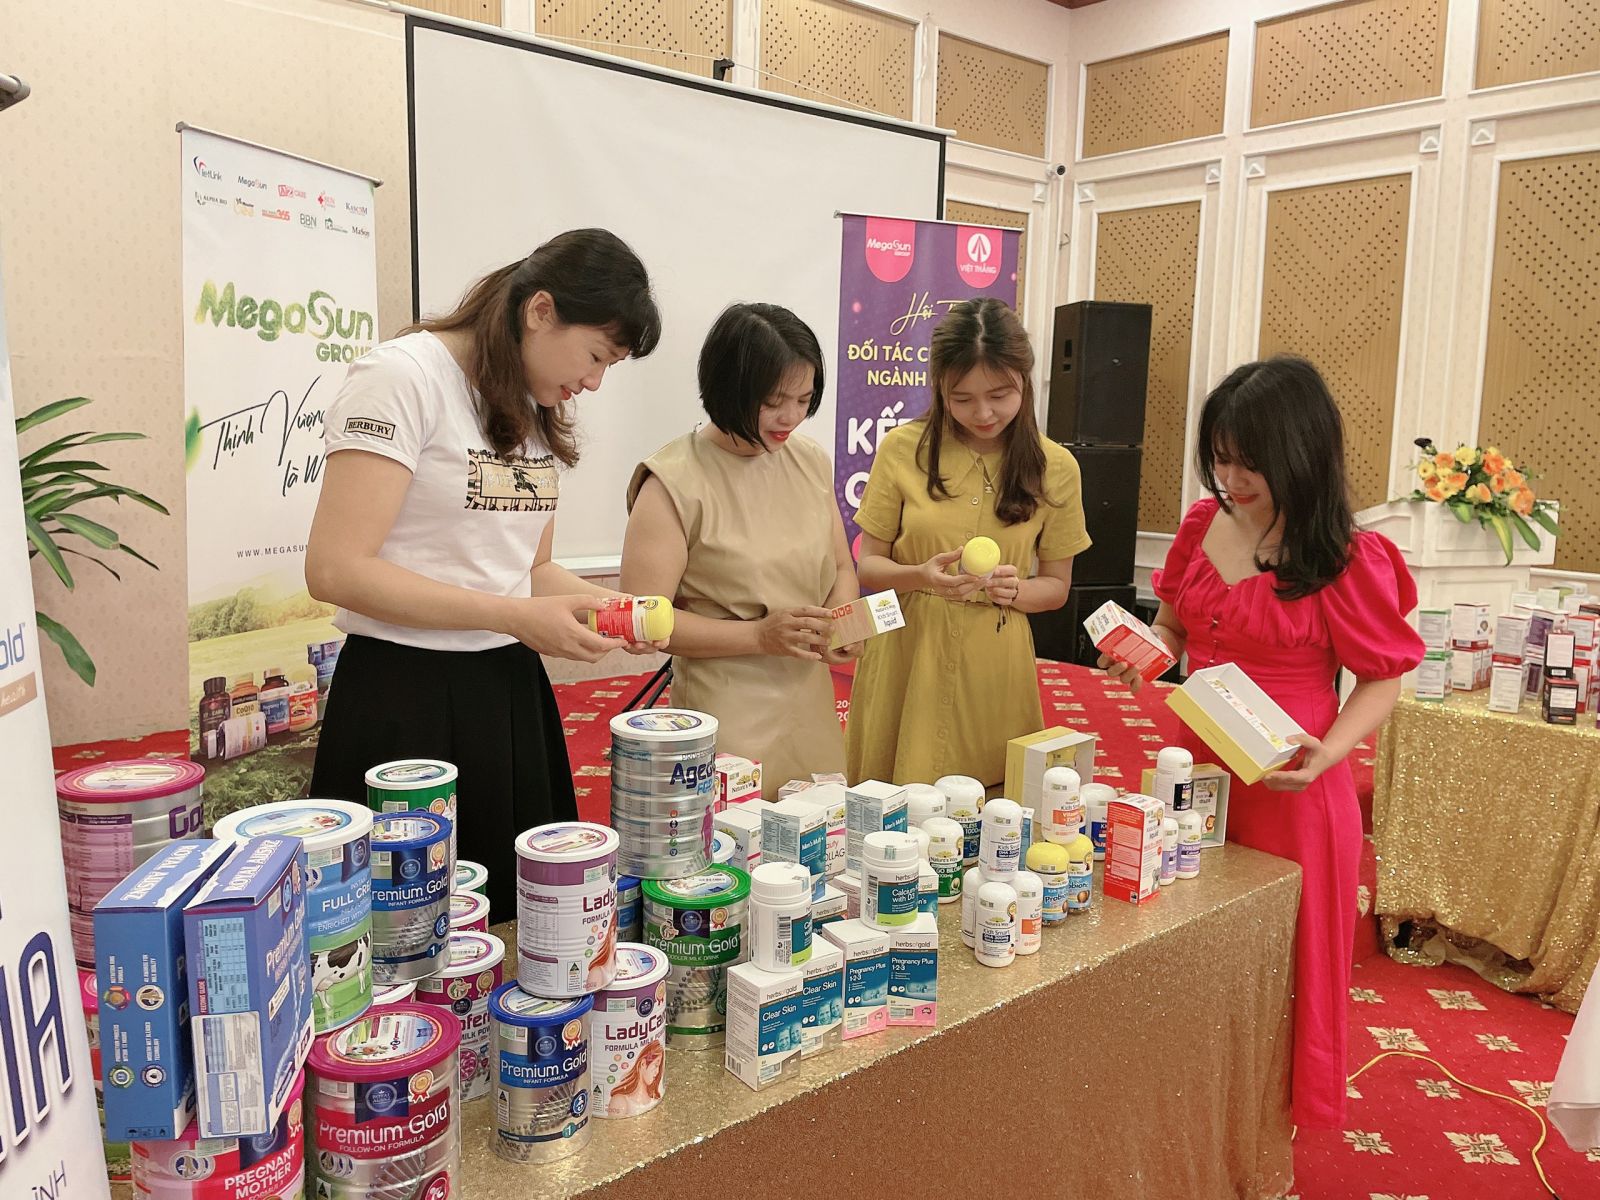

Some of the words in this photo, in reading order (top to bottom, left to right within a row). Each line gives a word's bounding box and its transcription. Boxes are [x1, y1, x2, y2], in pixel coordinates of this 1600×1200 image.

[867, 238, 911, 252] MegaSun
[194, 280, 373, 341] MegaSun
[848, 339, 878, 360] ĐỐI
[882, 342, 914, 363] TÁC
[917, 347, 929, 363] C
[867, 365, 927, 387] NGÀNH
[884, 617, 897, 628] liquid
[322, 893, 354, 912] FULL
[371, 887, 423, 902] remium
[582, 910, 610, 925] FORMULA
[709, 934, 739, 953] Gold
[891, 957, 920, 966] Pregnancy
[802, 983, 822, 996] Clear
[822, 979, 837, 990] Skin
[762, 1008, 782, 1022] Clear
[782, 1004, 797, 1016] Skin
[604, 1042, 639, 1052] FORMULA
[501, 1059, 559, 1079] Premium
[563, 1050, 588, 1072] Gold
[543, 1073, 569, 1084] FORMULA
[319, 1119, 403, 1145] Premium
[409, 1101, 448, 1134] Gold
[339, 1143, 386, 1154] FOLLOW-ON
[388, 1134, 425, 1150] FORMULA
[224, 1143, 296, 1191] PREGNANT
[235, 1162, 292, 1200] MOTHER
